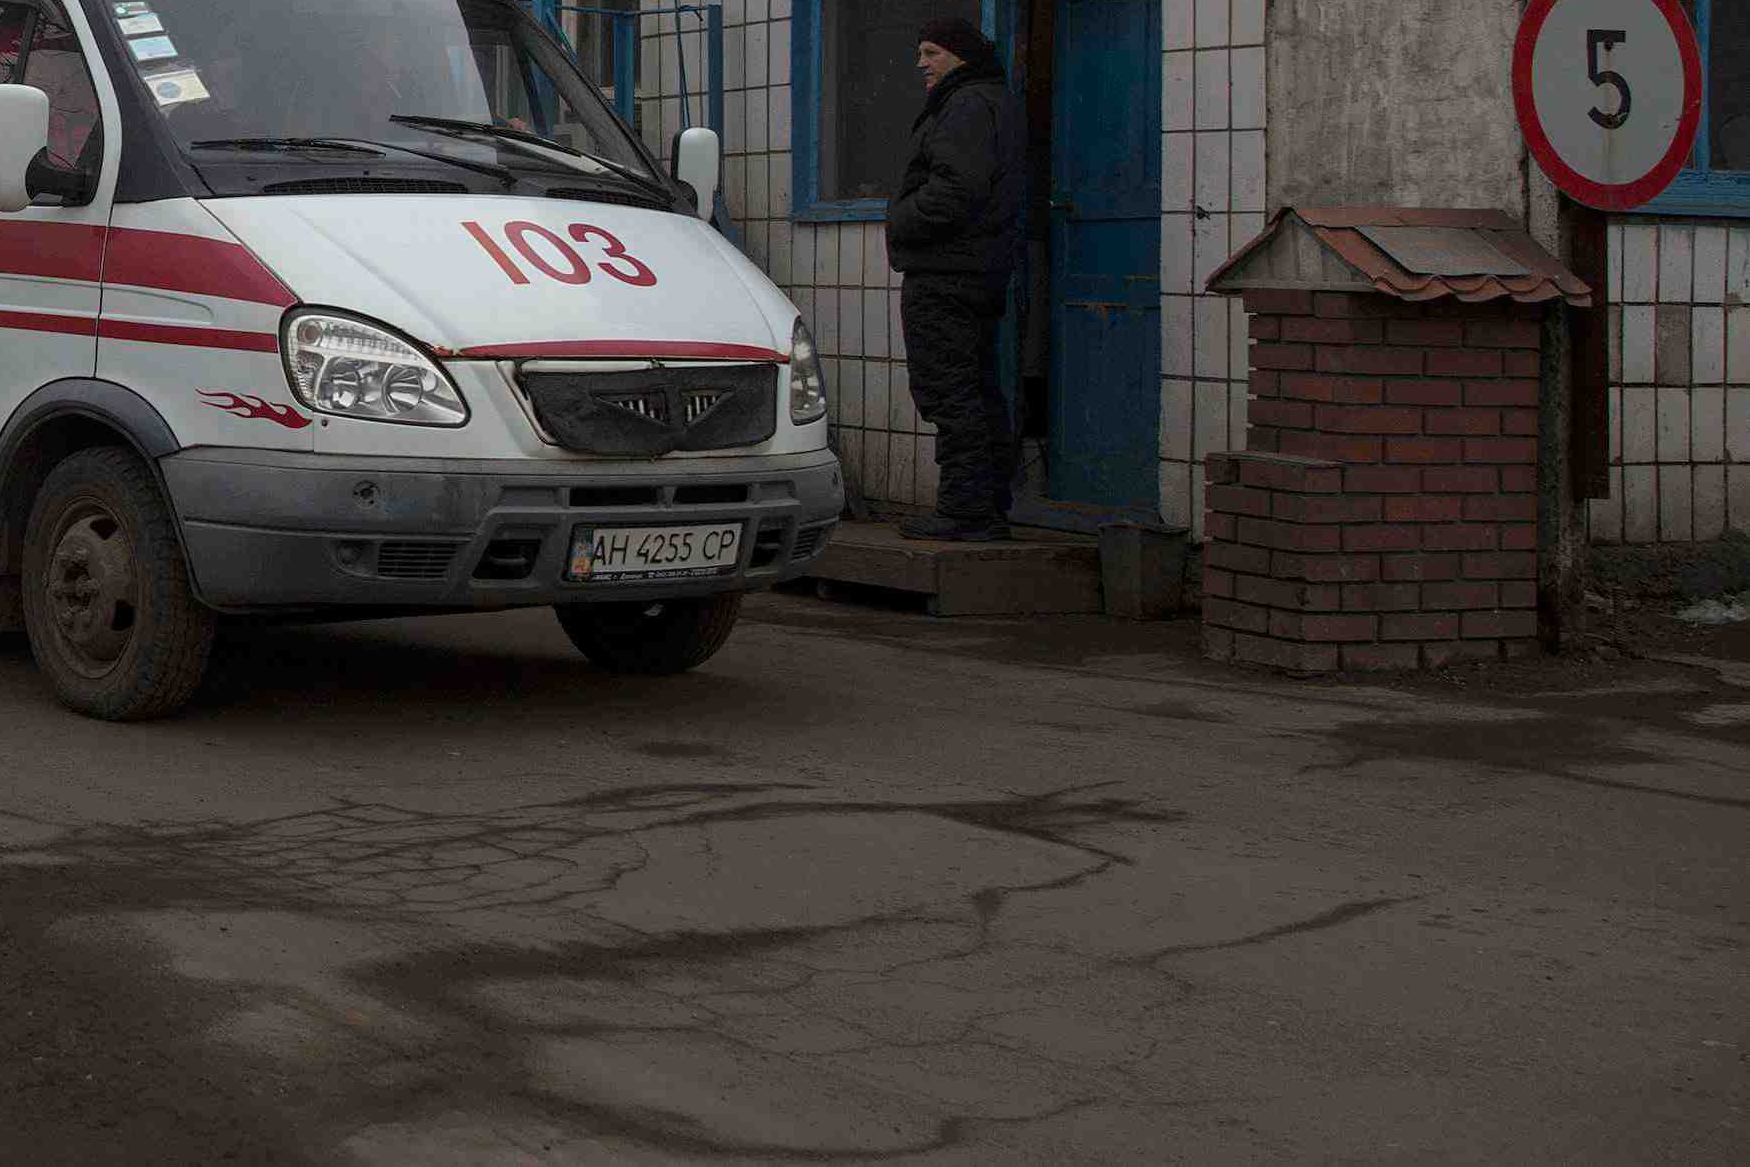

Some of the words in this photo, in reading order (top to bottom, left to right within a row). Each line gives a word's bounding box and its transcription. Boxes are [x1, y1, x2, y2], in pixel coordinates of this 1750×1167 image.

[1586, 29, 1632, 131] 5
[459, 220, 658, 287] 103
[593, 535, 629, 565] AH
[636, 532, 694, 565] 4255
[702, 529, 736, 561] CP
